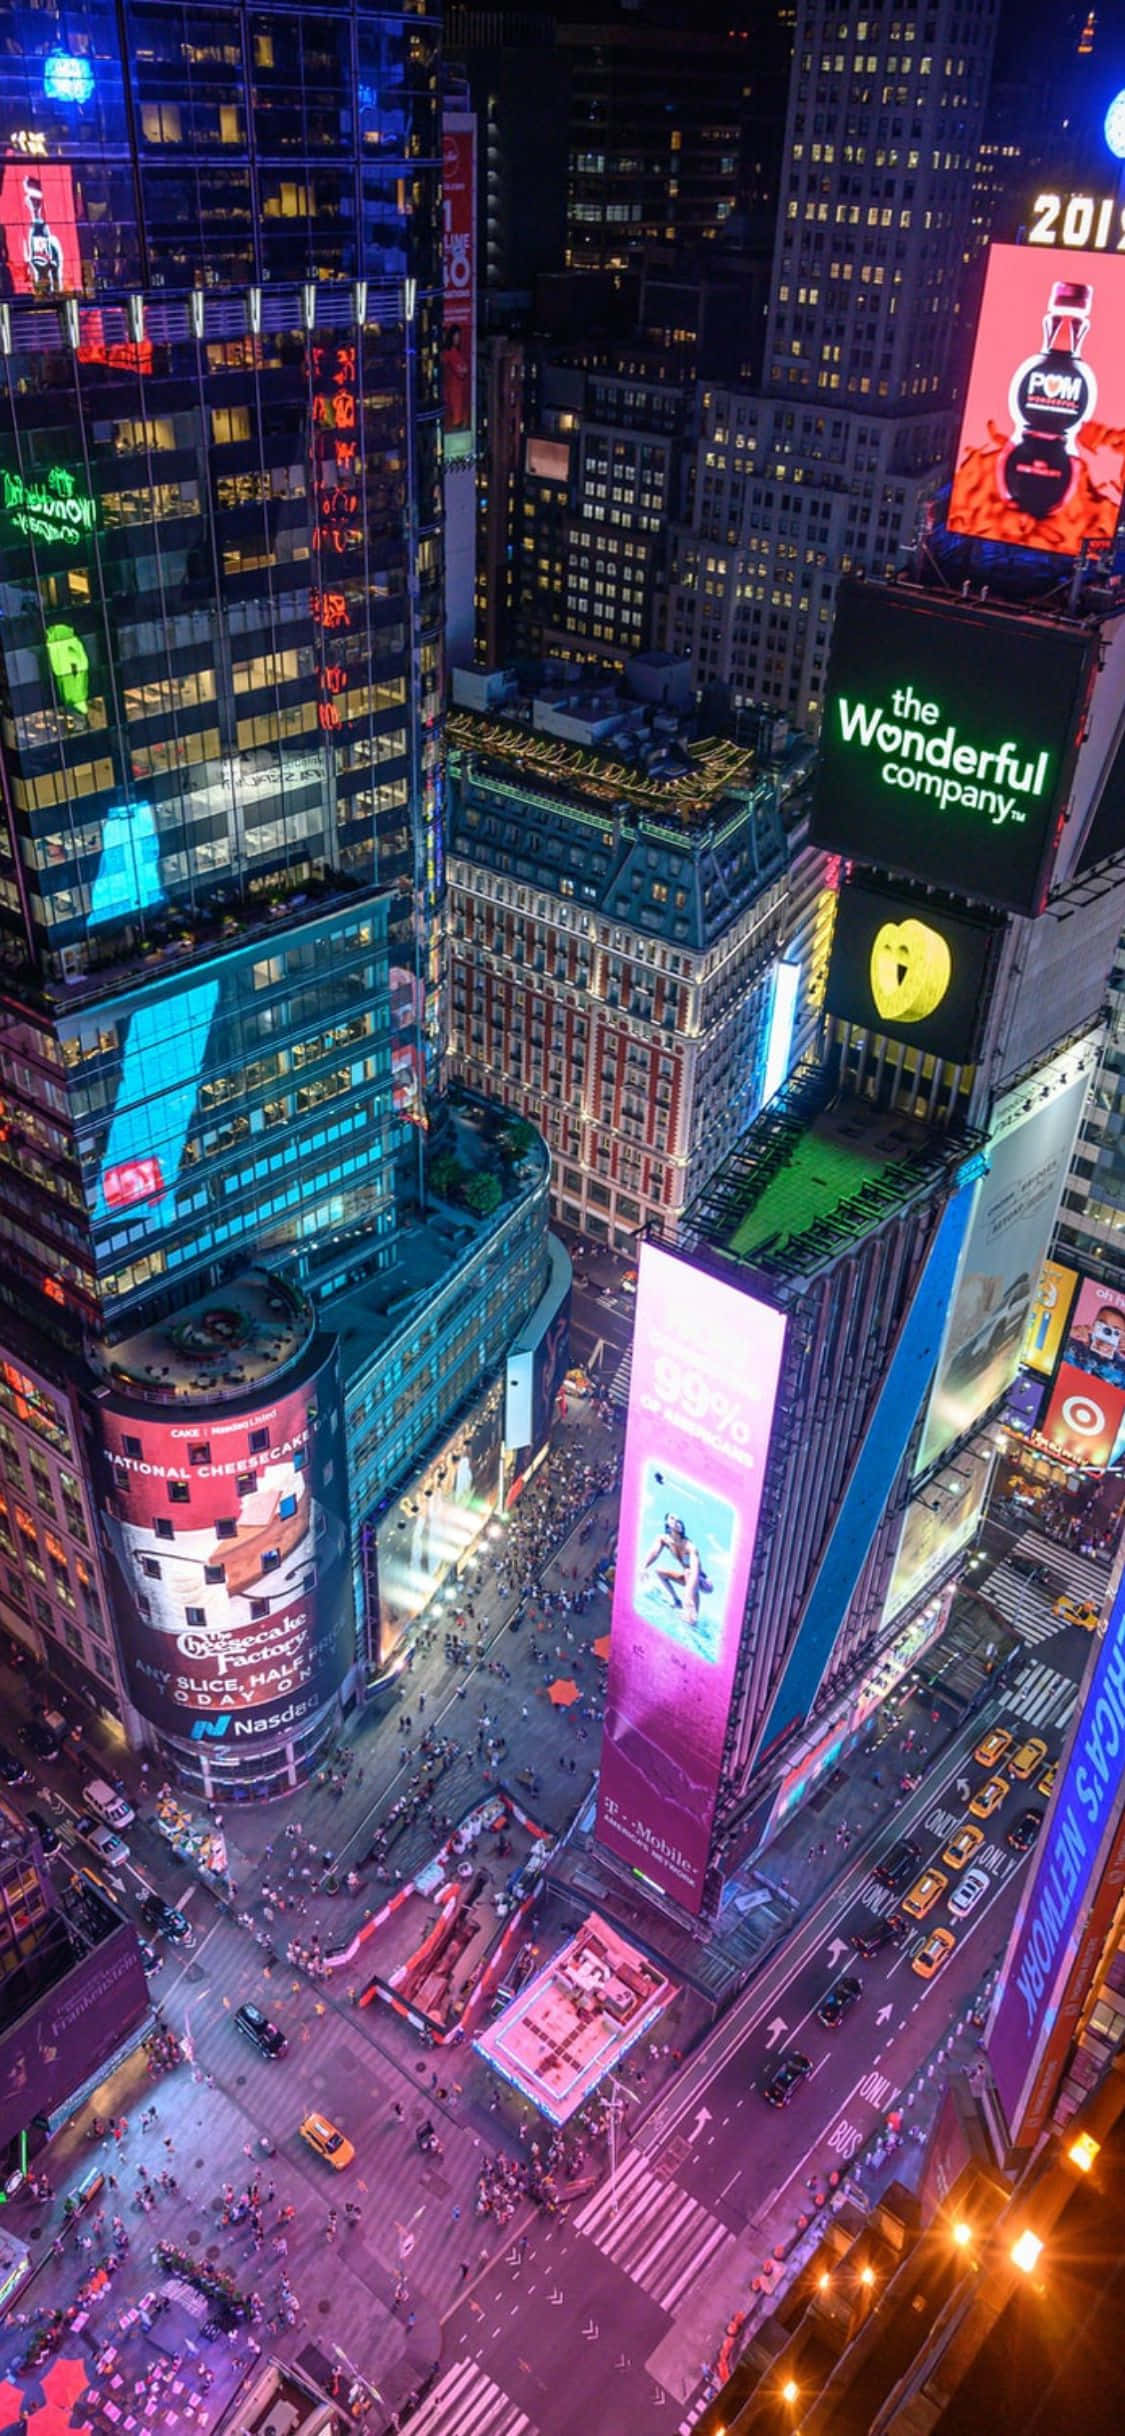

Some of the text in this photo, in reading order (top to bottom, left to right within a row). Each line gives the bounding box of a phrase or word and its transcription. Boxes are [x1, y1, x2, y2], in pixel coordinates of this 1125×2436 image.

[1028, 371, 1082, 402] POM
[892, 686, 940, 726] the
[839, 697, 1049, 796] Wonderful
[170, 1428, 200, 1438] CAKE
[197, 1430, 311, 1479] CHEESECAKE
[177, 1613, 306, 1660] Cheesecake
[176, 1675, 246, 1693] SLICE,
[250, 1656, 306, 1689] HALF
[234, 1693, 320, 1737] Nasdaq
[978, 1844, 1017, 1879] ONLY
[860, 2072, 902, 2113] ONLY
[827, 2119, 863, 2159] BUS
